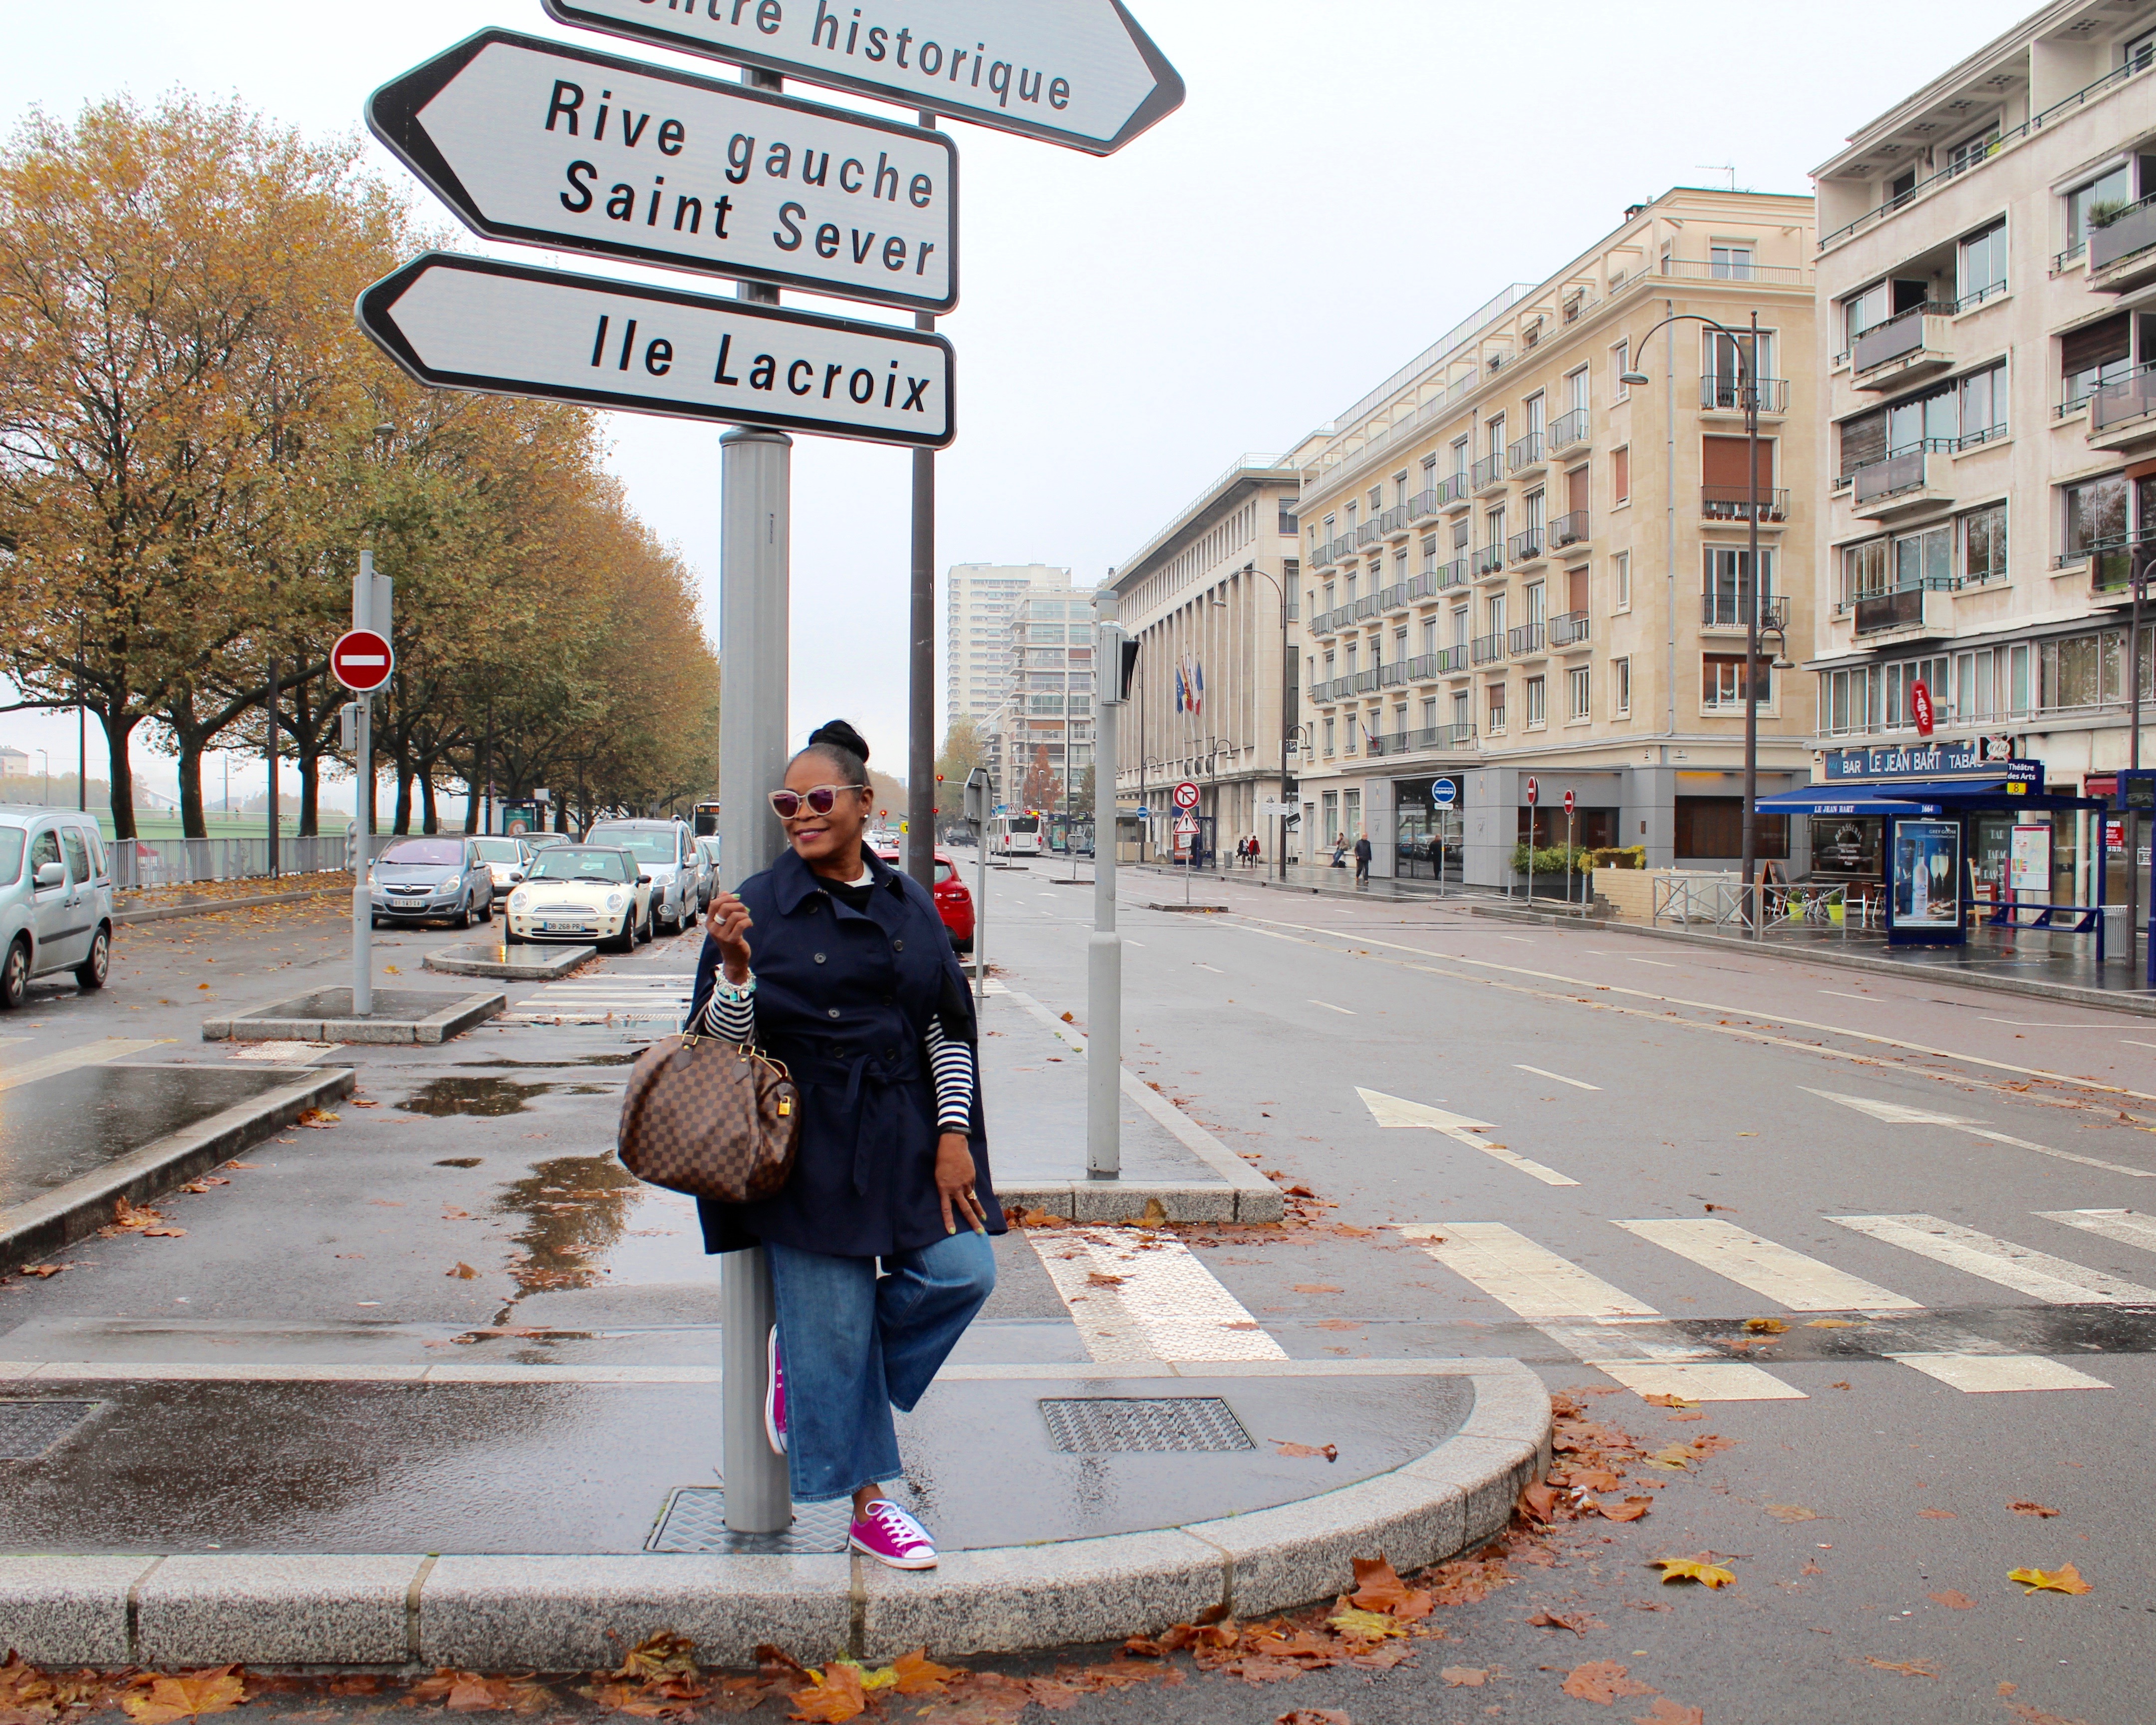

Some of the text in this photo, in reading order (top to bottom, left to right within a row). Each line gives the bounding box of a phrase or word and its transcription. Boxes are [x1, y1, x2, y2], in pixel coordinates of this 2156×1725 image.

[811, 0, 1070, 110] historique
[545, 79, 932, 208] Rive gauche
[560, 160, 934, 275] Saint Sever
[591, 315, 929, 412] Ile Lacroix
[1916, 690, 1928, 725] TABAC
[1842, 760, 1861, 774] BAR
[1869, 754, 1881, 773] LE
[1884, 753, 1909, 772] JEAN
[1913, 751, 1941, 771] BART
[1989, 743, 2008, 753] 1664
[2008, 763, 2034, 771] Théâtre
[2014, 784, 2019, 792] 8
[1835, 823, 1863, 842] BRASSERIE
